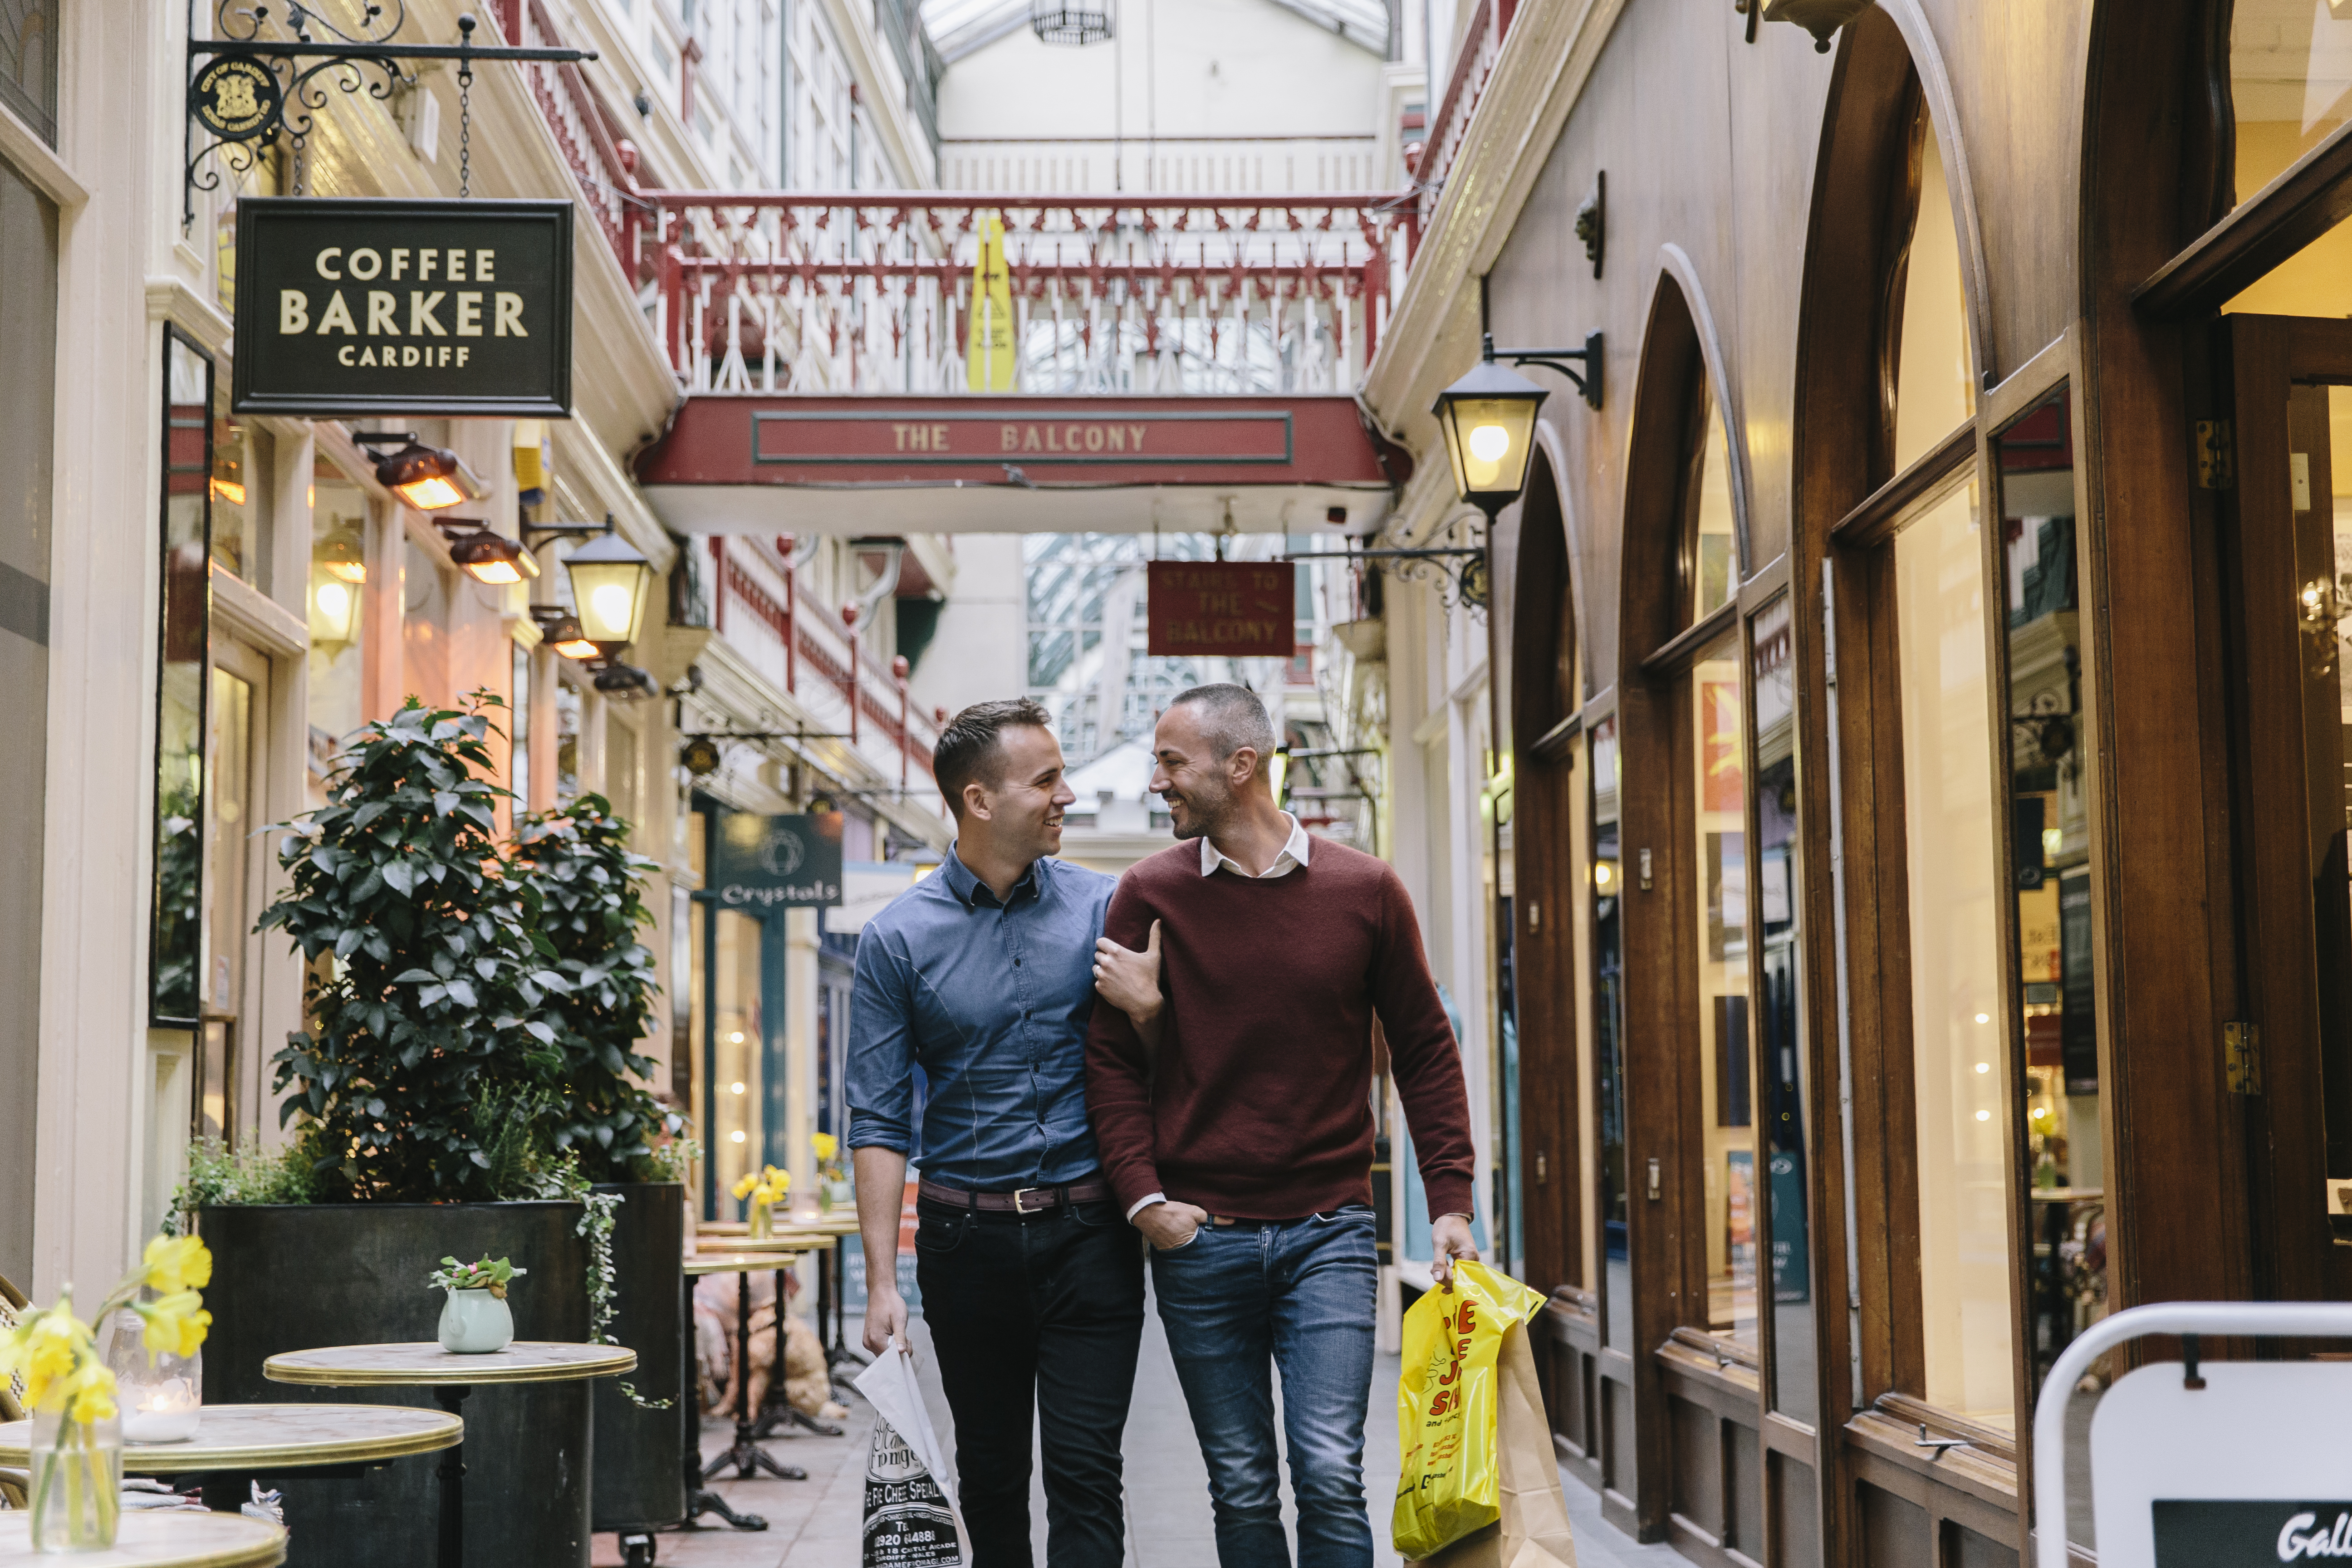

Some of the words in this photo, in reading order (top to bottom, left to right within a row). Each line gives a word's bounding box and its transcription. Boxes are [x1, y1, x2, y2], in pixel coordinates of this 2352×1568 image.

[316, 247, 495, 281] COFFEE
[279, 289, 529, 337] BARKER
[338, 345, 470, 368] CARDIFF
[892, 423, 950, 452] THE
[1001, 423, 1147, 452] BALCONY
[1252, 571, 1279, 591] TO
[1198, 591, 1243, 616] THE
[1166, 620, 1277, 644] BALCONY
[721, 879, 839, 907] Crystals
[928, 1542, 957, 1550] ACADE
[876, 1554, 906, 1563] CRDIFF
